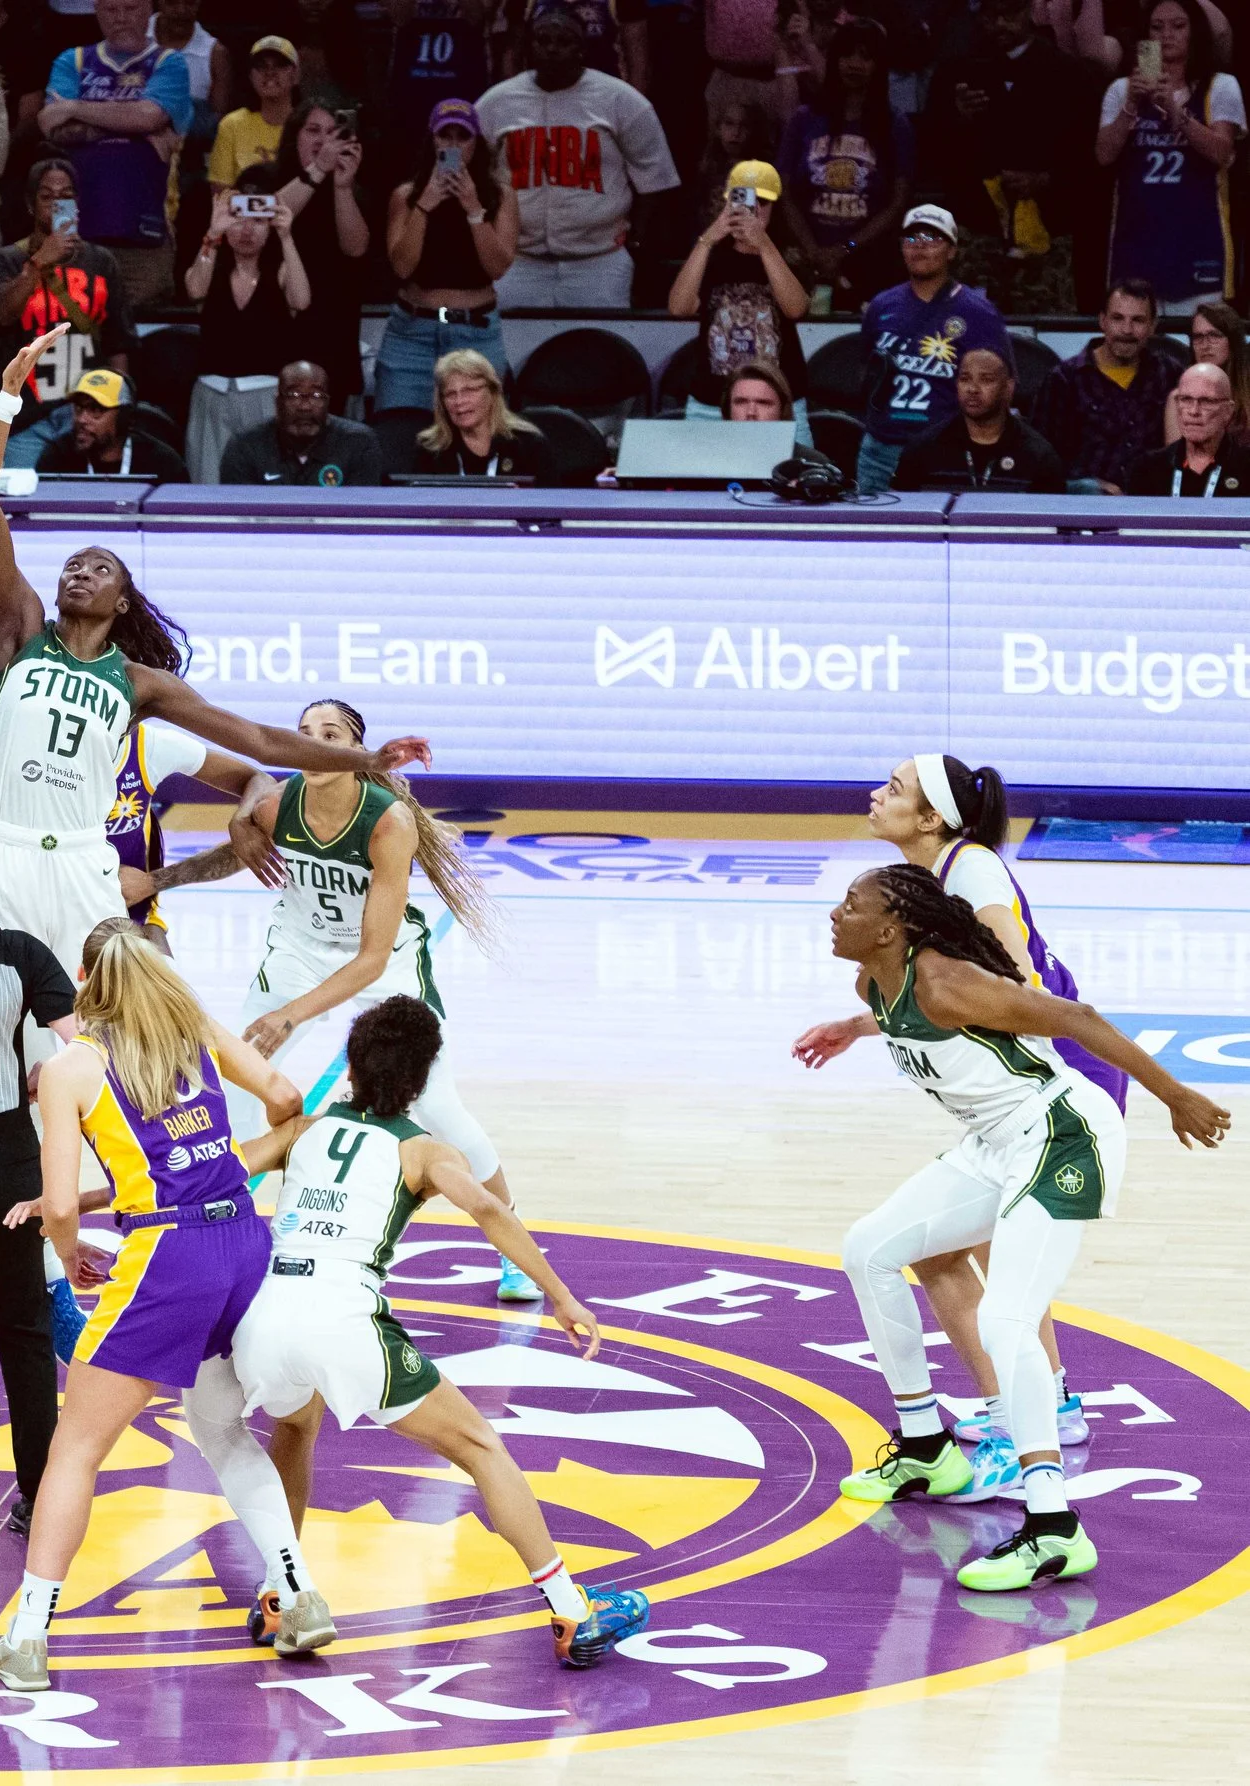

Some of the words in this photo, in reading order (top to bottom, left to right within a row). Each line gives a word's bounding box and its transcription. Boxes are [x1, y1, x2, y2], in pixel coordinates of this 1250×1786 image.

[416, 32, 454, 64] 10
[507, 125, 604, 192] WNBA
[1143, 150, 1185, 184] 22
[890, 374, 932, 410] 22
[190, 622, 319, 684] end.
[338, 622, 506, 686] Earn.
[694, 626, 910, 691] Albert
[1002, 632, 1250, 713] Budget
[19, 667, 120, 733] STORM
[46, 707, 88, 759] 13
[120, 780, 142, 790] Albert
[580, 872, 822, 886] HATE
[317, 892, 344, 922] 5
[162, 1105, 214, 1141] BARKER
[191, 1136, 229, 1162] AT&T
[327, 1127, 369, 1184] 4
[296, 1187, 348, 1213] DIGGINS
[299, 1219, 348, 1238] AT&T
